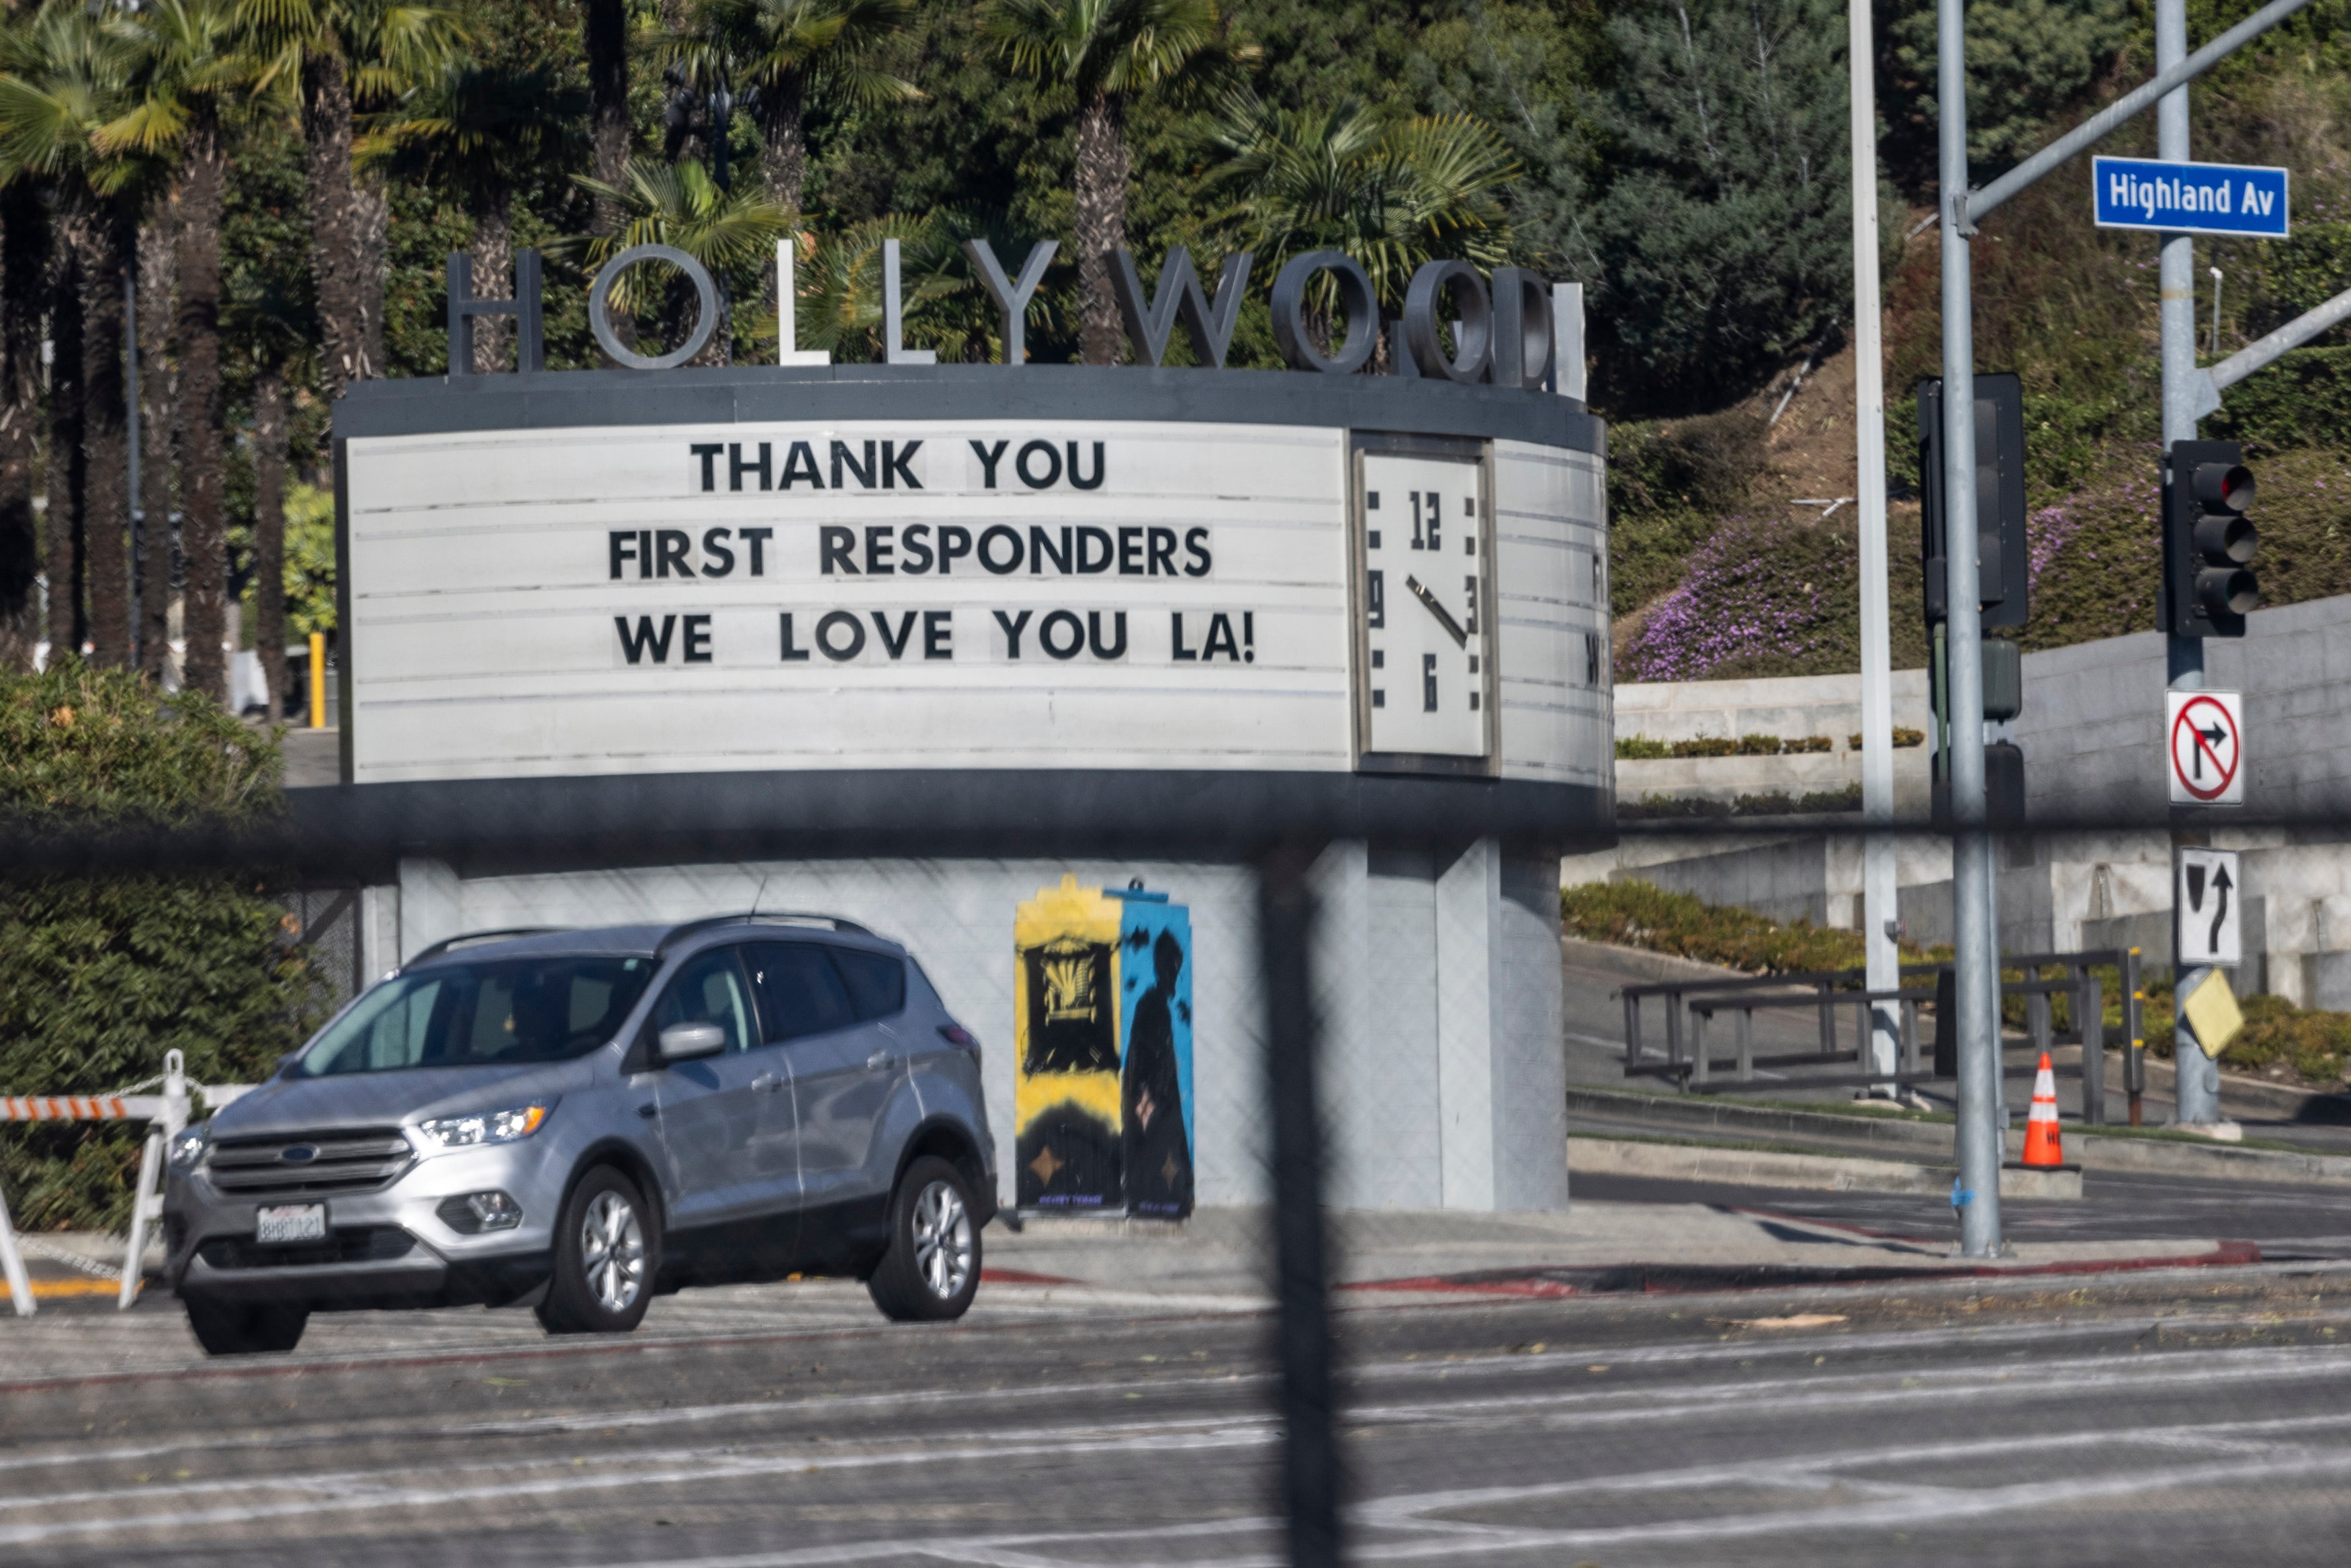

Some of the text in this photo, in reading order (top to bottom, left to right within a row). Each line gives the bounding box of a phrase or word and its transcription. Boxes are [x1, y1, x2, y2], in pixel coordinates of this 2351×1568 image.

[2109, 172, 2275, 220] Highland Av
[447, 238, 1556, 389] HOLLYWOOD
[691, 439, 1106, 492] THANK YOU
[1409, 491, 1441, 551] 12
[609, 524, 1212, 580] FIRST RESPONDERS
[1368, 570, 1478, 634] 9 3
[614, 610, 1255, 664] WE LOVE YOU LA!
[1423, 653, 1437, 712] 6
